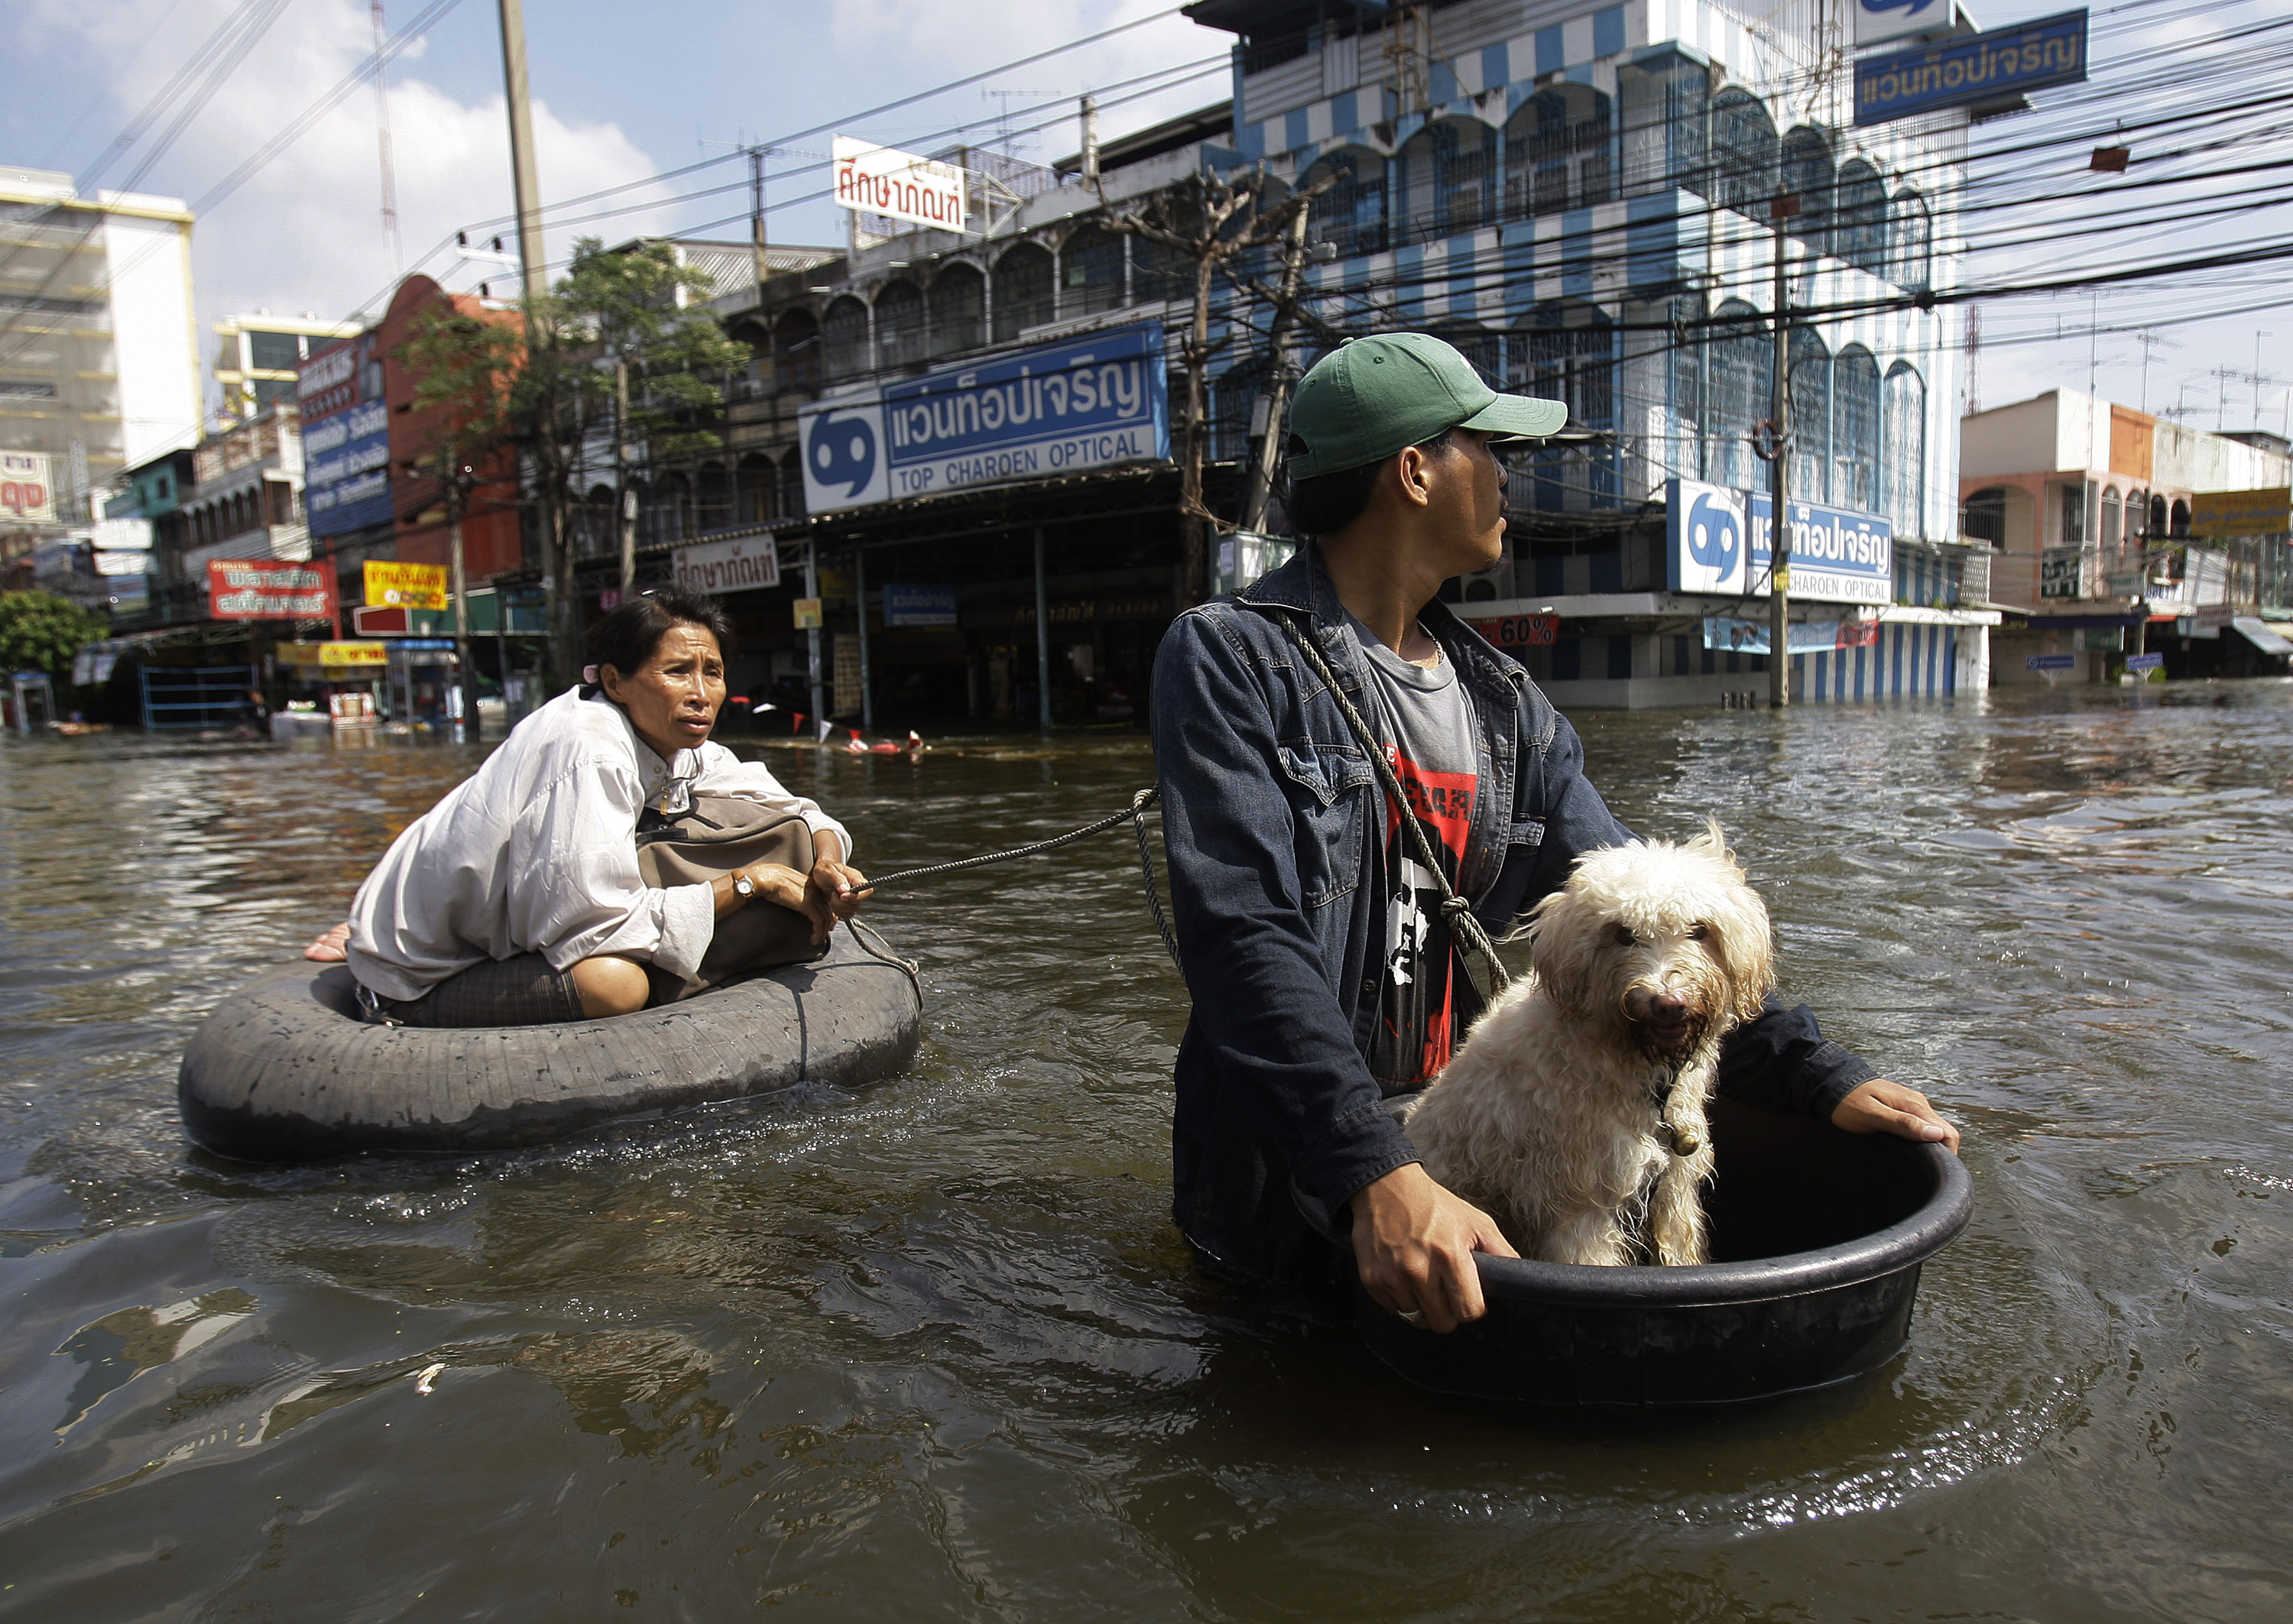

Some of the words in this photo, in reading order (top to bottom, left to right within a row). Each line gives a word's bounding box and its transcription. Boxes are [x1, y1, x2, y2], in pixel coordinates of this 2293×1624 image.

[1863, 32, 2077, 105] แว่นท็อปเจริญ
[892, 354, 1143, 448] แว่นท็อปเจริญ
[898, 468, 933, 492] TOP
[945, 449, 1038, 485] CHAROEN
[1049, 427, 1143, 468] OPTICAL
[1844, 579, 1886, 600] OPTICAL
